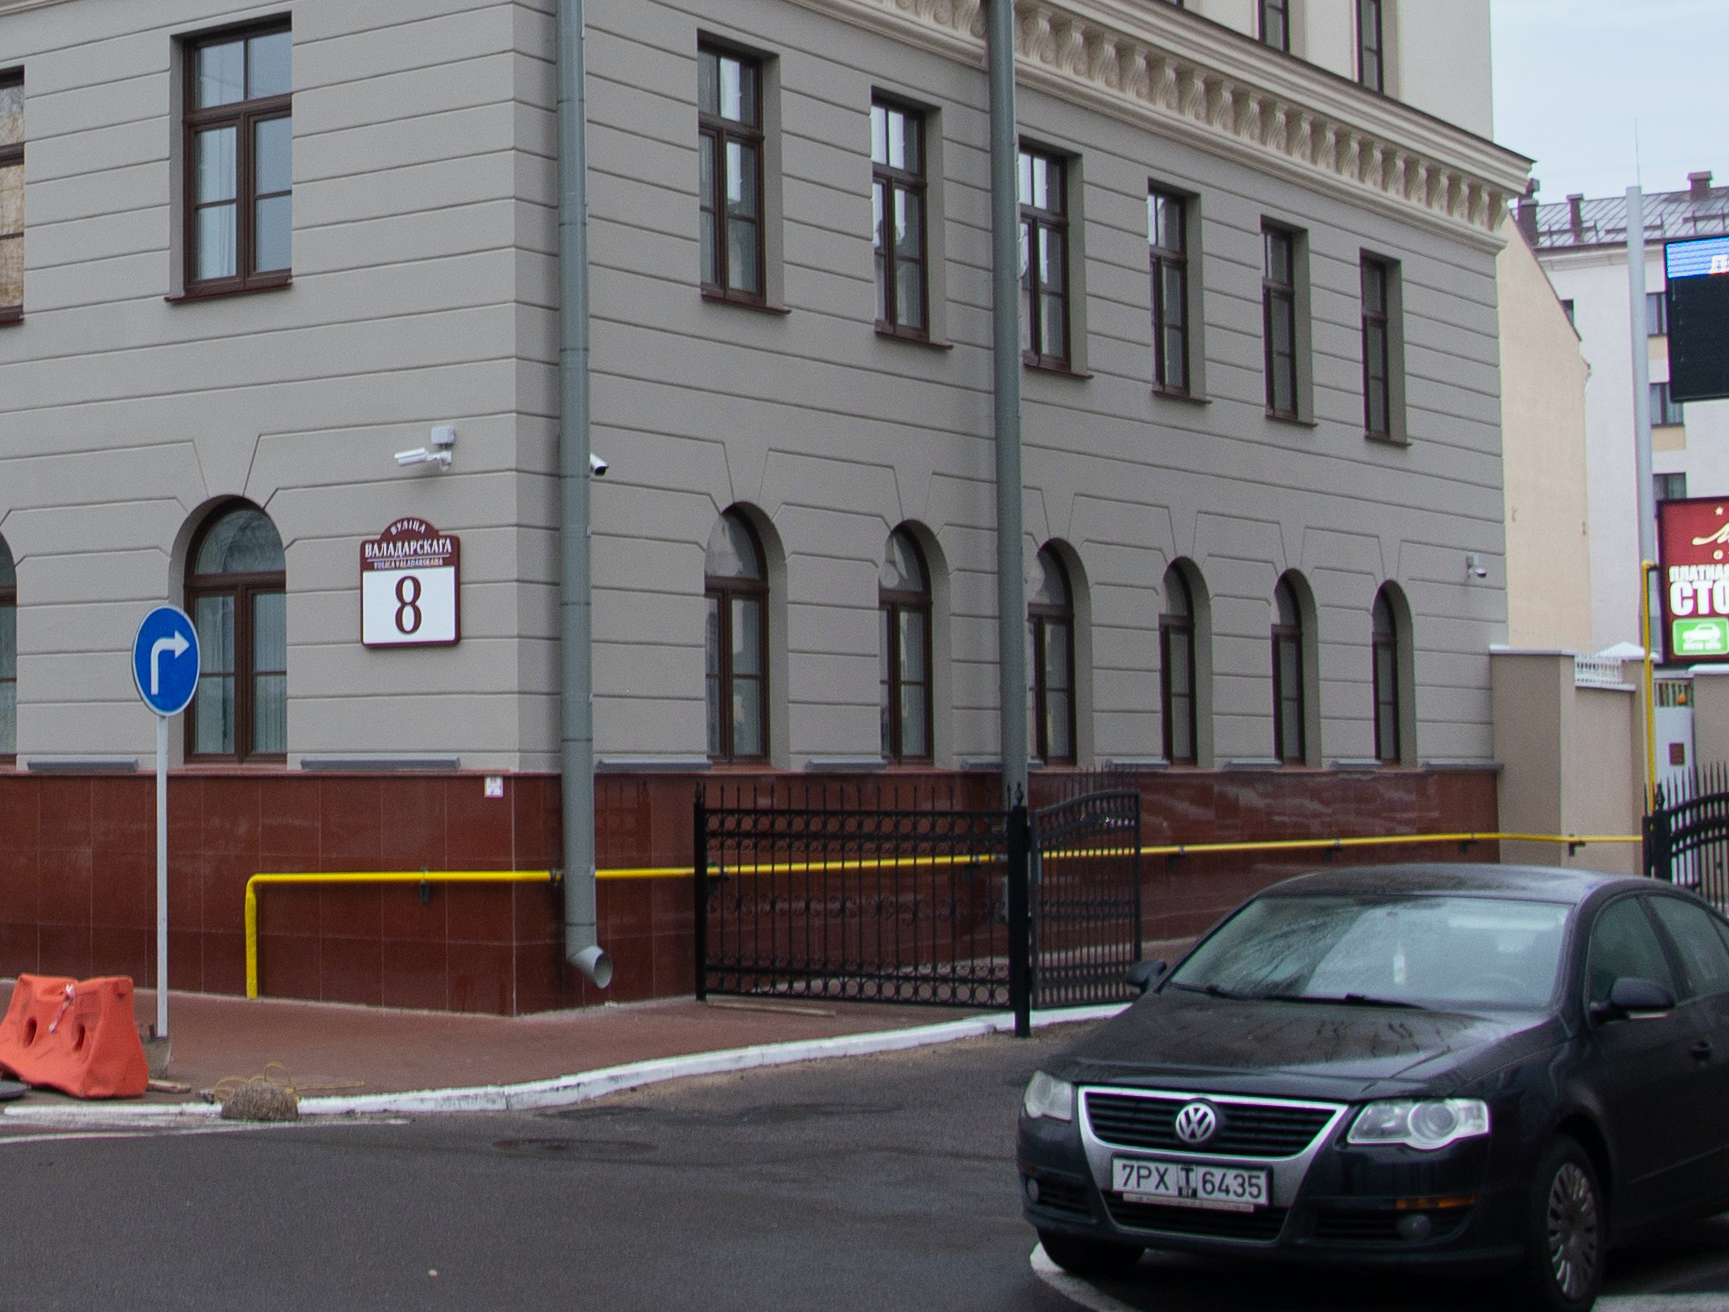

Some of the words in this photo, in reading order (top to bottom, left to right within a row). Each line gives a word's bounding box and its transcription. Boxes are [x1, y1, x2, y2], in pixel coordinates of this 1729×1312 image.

[390, 519, 426, 536] ВУЛІЦА
[365, 538, 452, 559] ВАЛАДАРСКАГА
[395, 575, 422, 635] 8
[1121, 1163, 1170, 1192] 7PX
[1201, 1170, 1262, 1200] 6435
